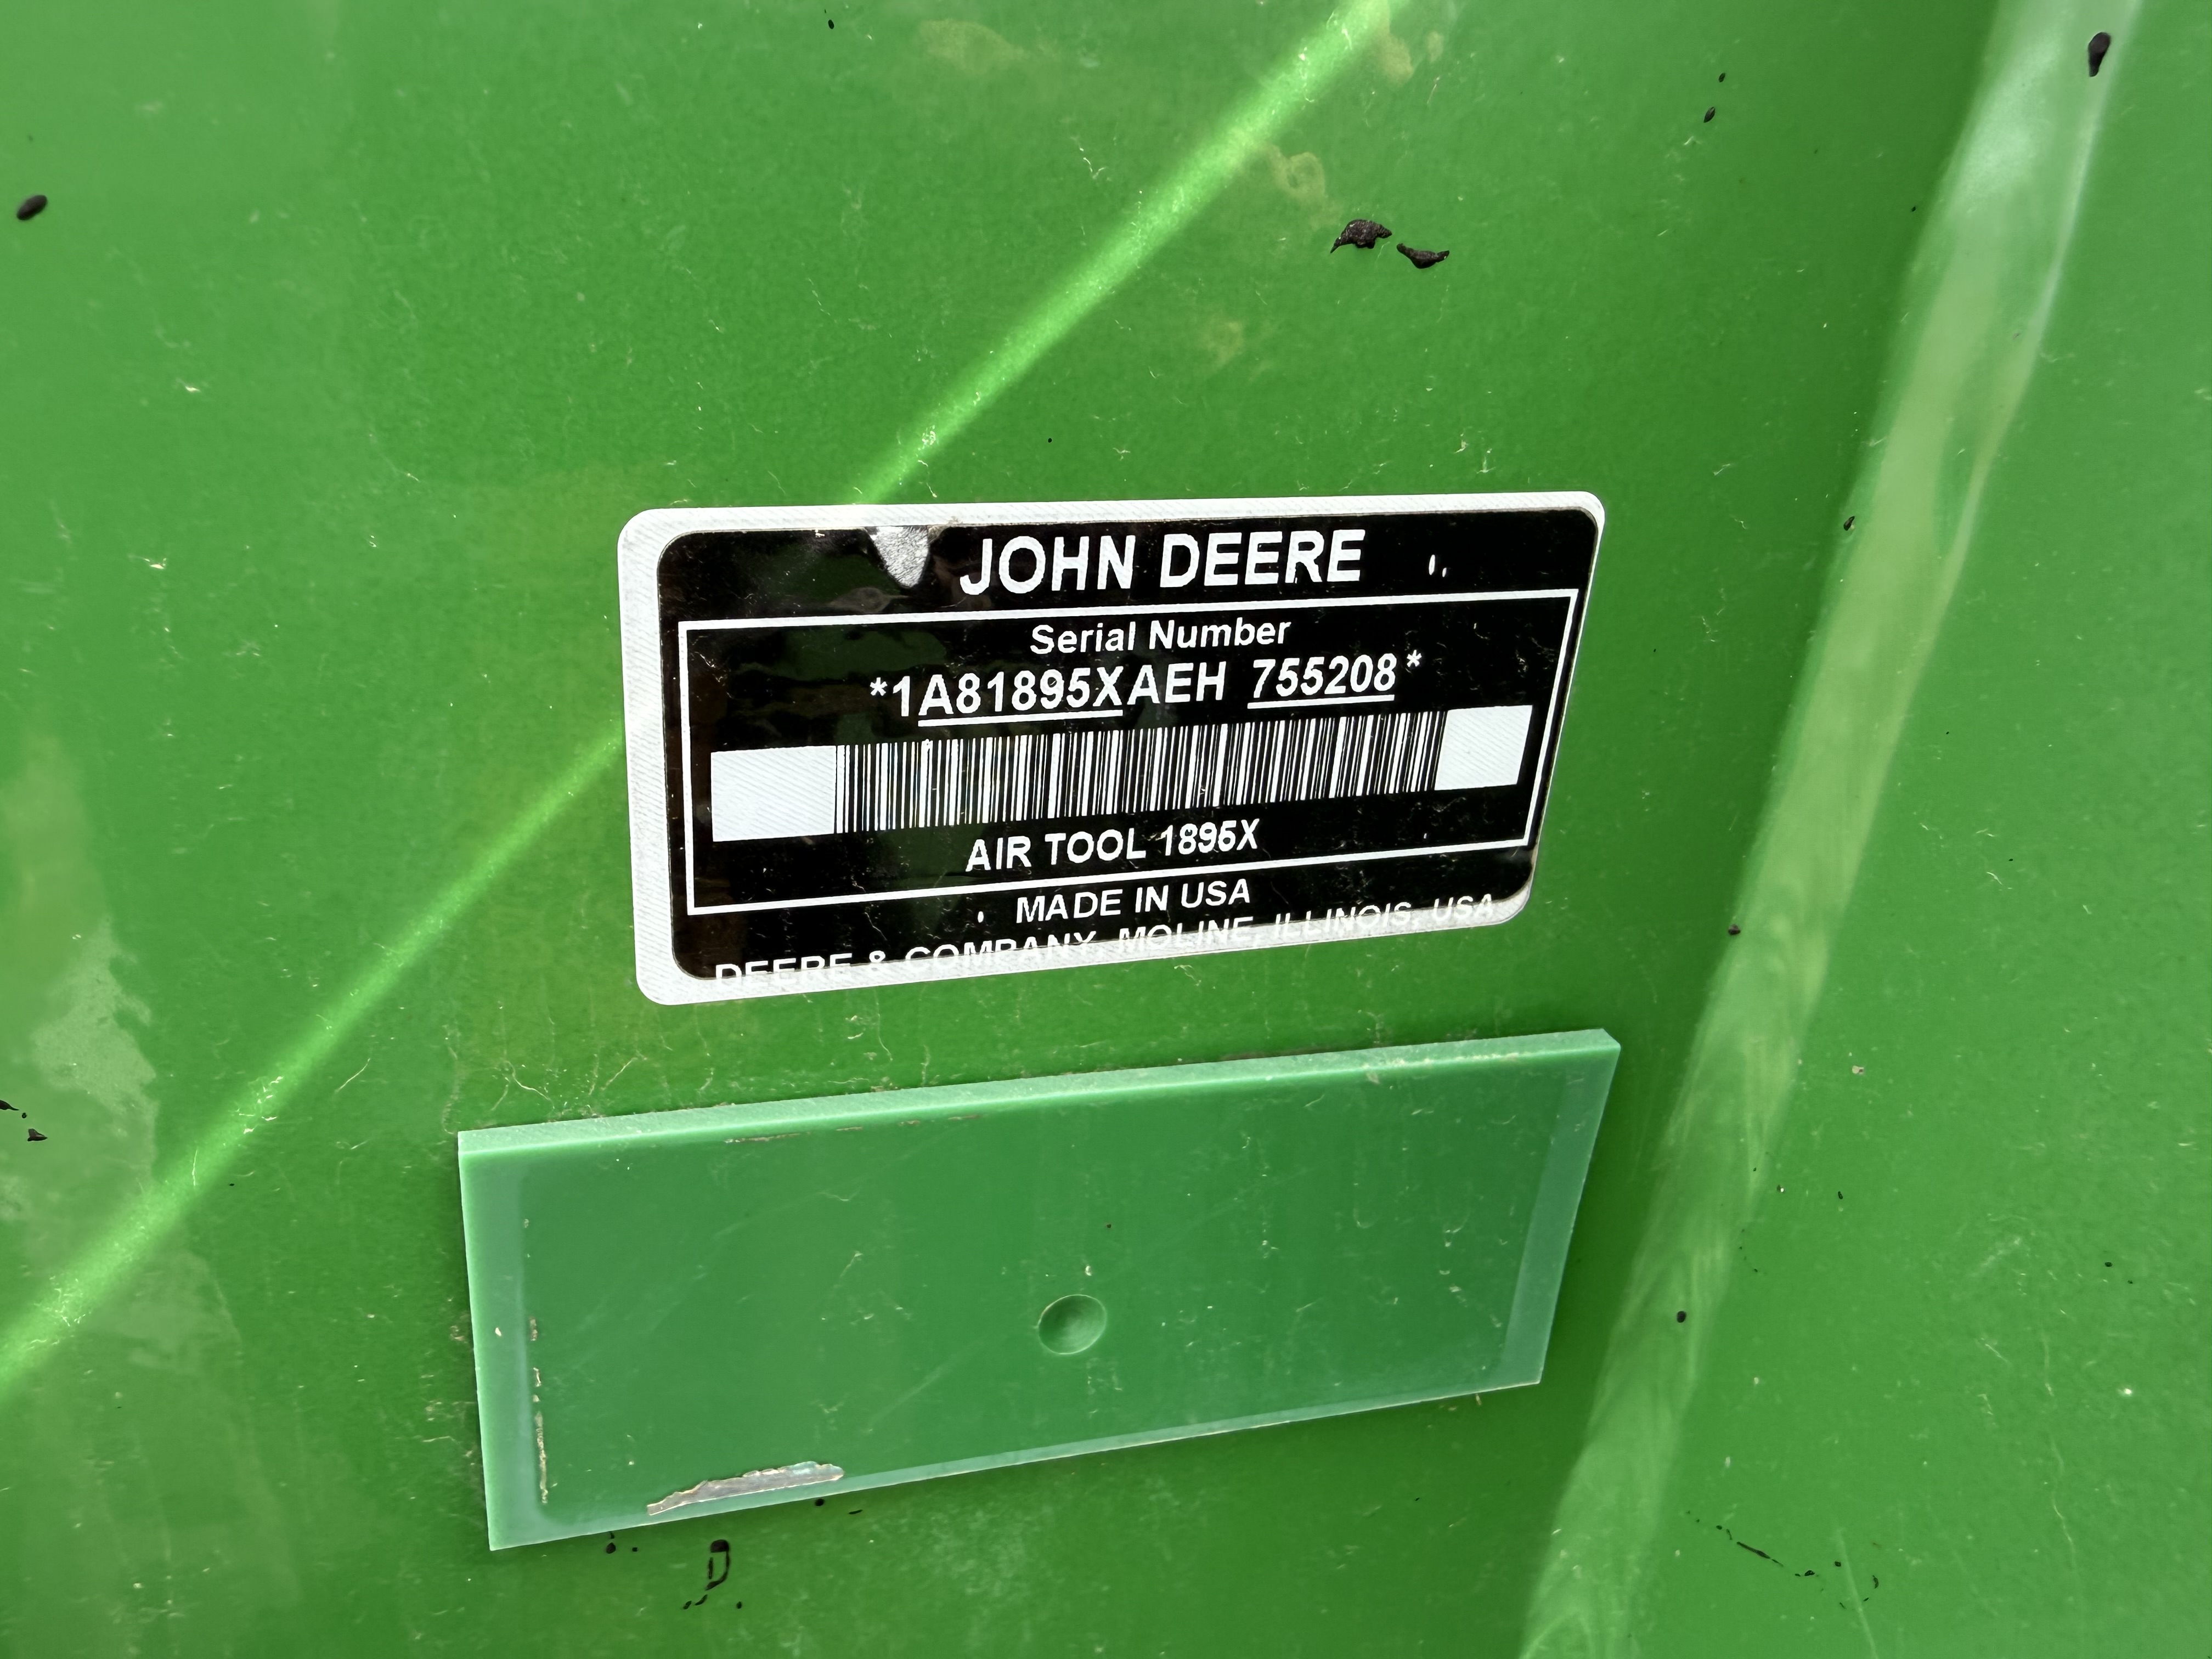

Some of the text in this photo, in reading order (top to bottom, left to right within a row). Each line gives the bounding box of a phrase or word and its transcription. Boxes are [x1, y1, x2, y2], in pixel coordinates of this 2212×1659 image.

[960, 529, 1365, 595] JOHN DEERE
[1030, 617, 1291, 654] Serial Number
[965, 836, 1032, 872] AIR
[1045, 828, 1147, 865] TOOL
[1016, 878, 1250, 923] MADE IN USA
